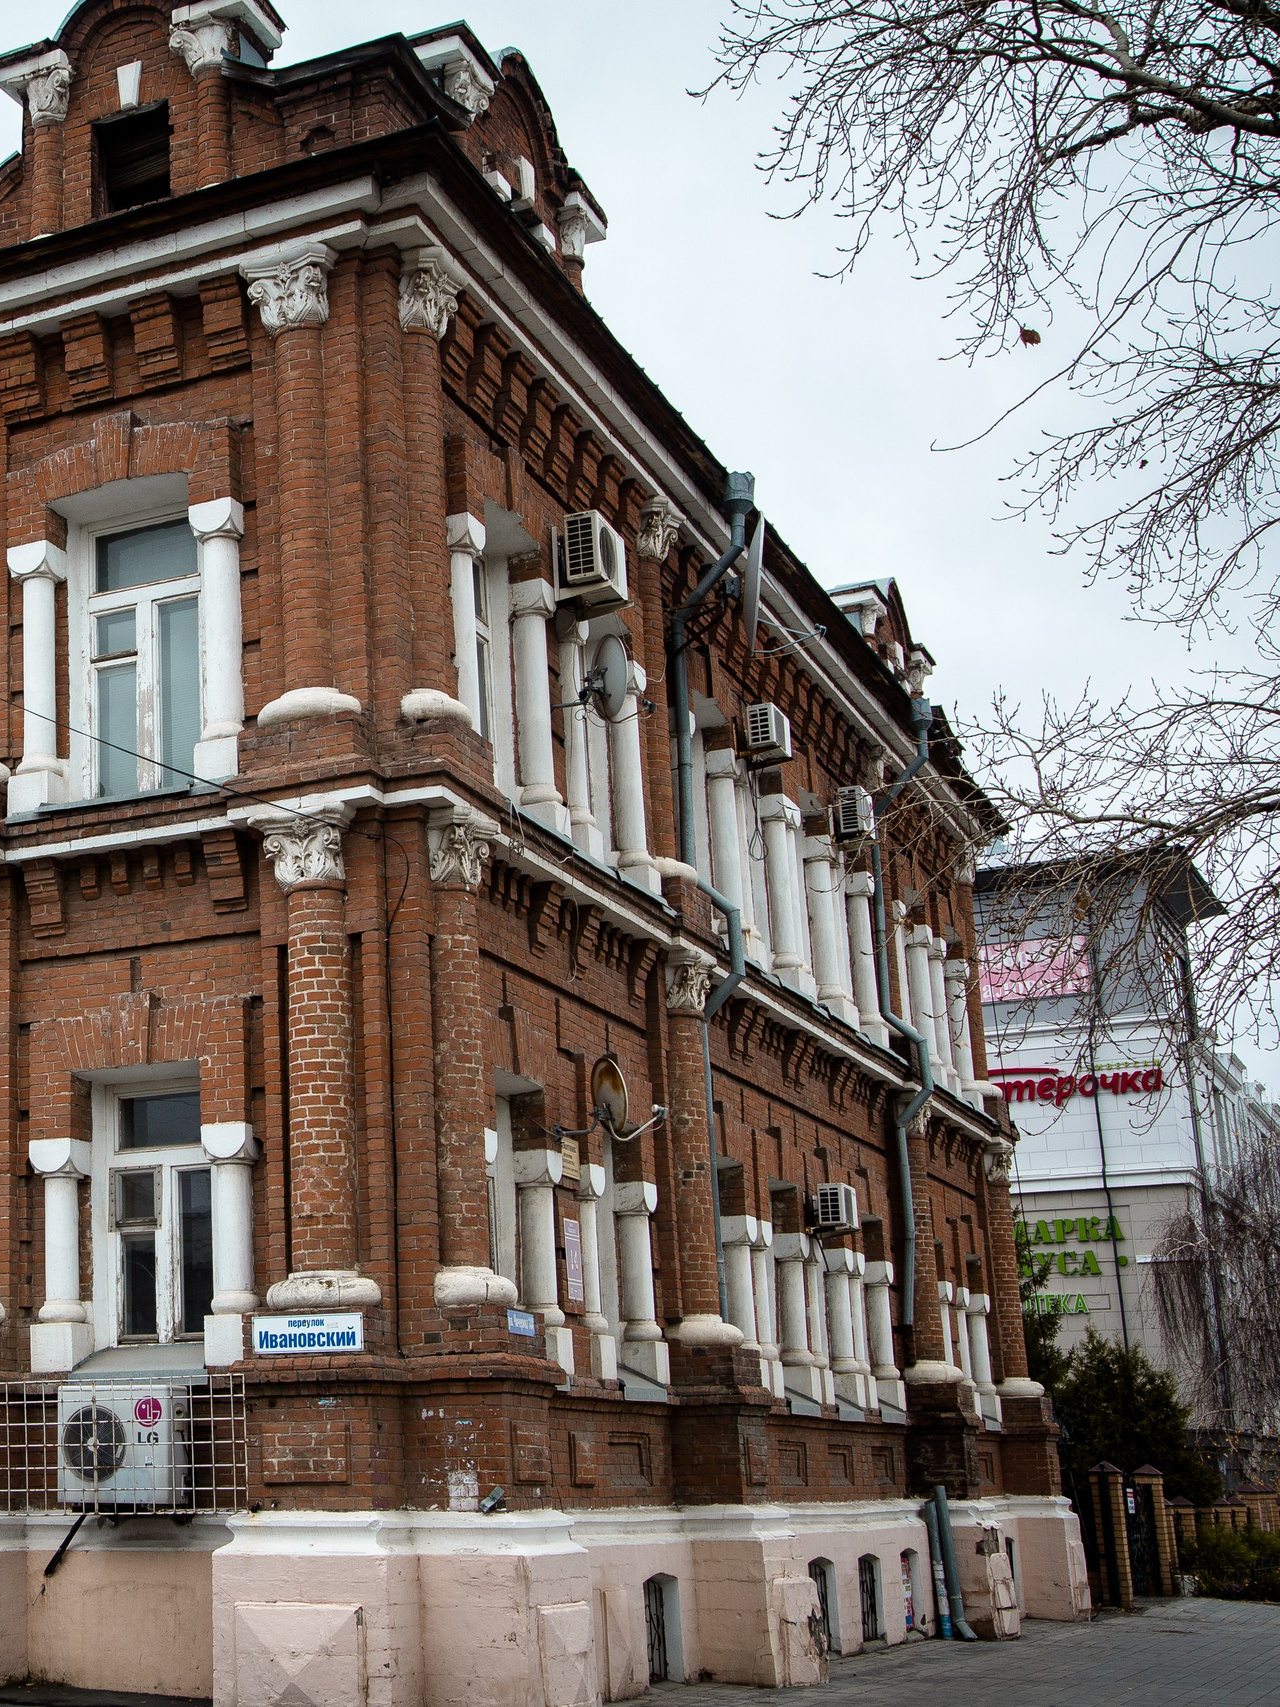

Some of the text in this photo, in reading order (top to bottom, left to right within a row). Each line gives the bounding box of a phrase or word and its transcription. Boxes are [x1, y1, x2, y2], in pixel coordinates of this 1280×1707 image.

[287, 1318, 325, 1329] переулок
[258, 1326, 356, 1349] Ивановский
[137, 1431, 159, 1444] LG
